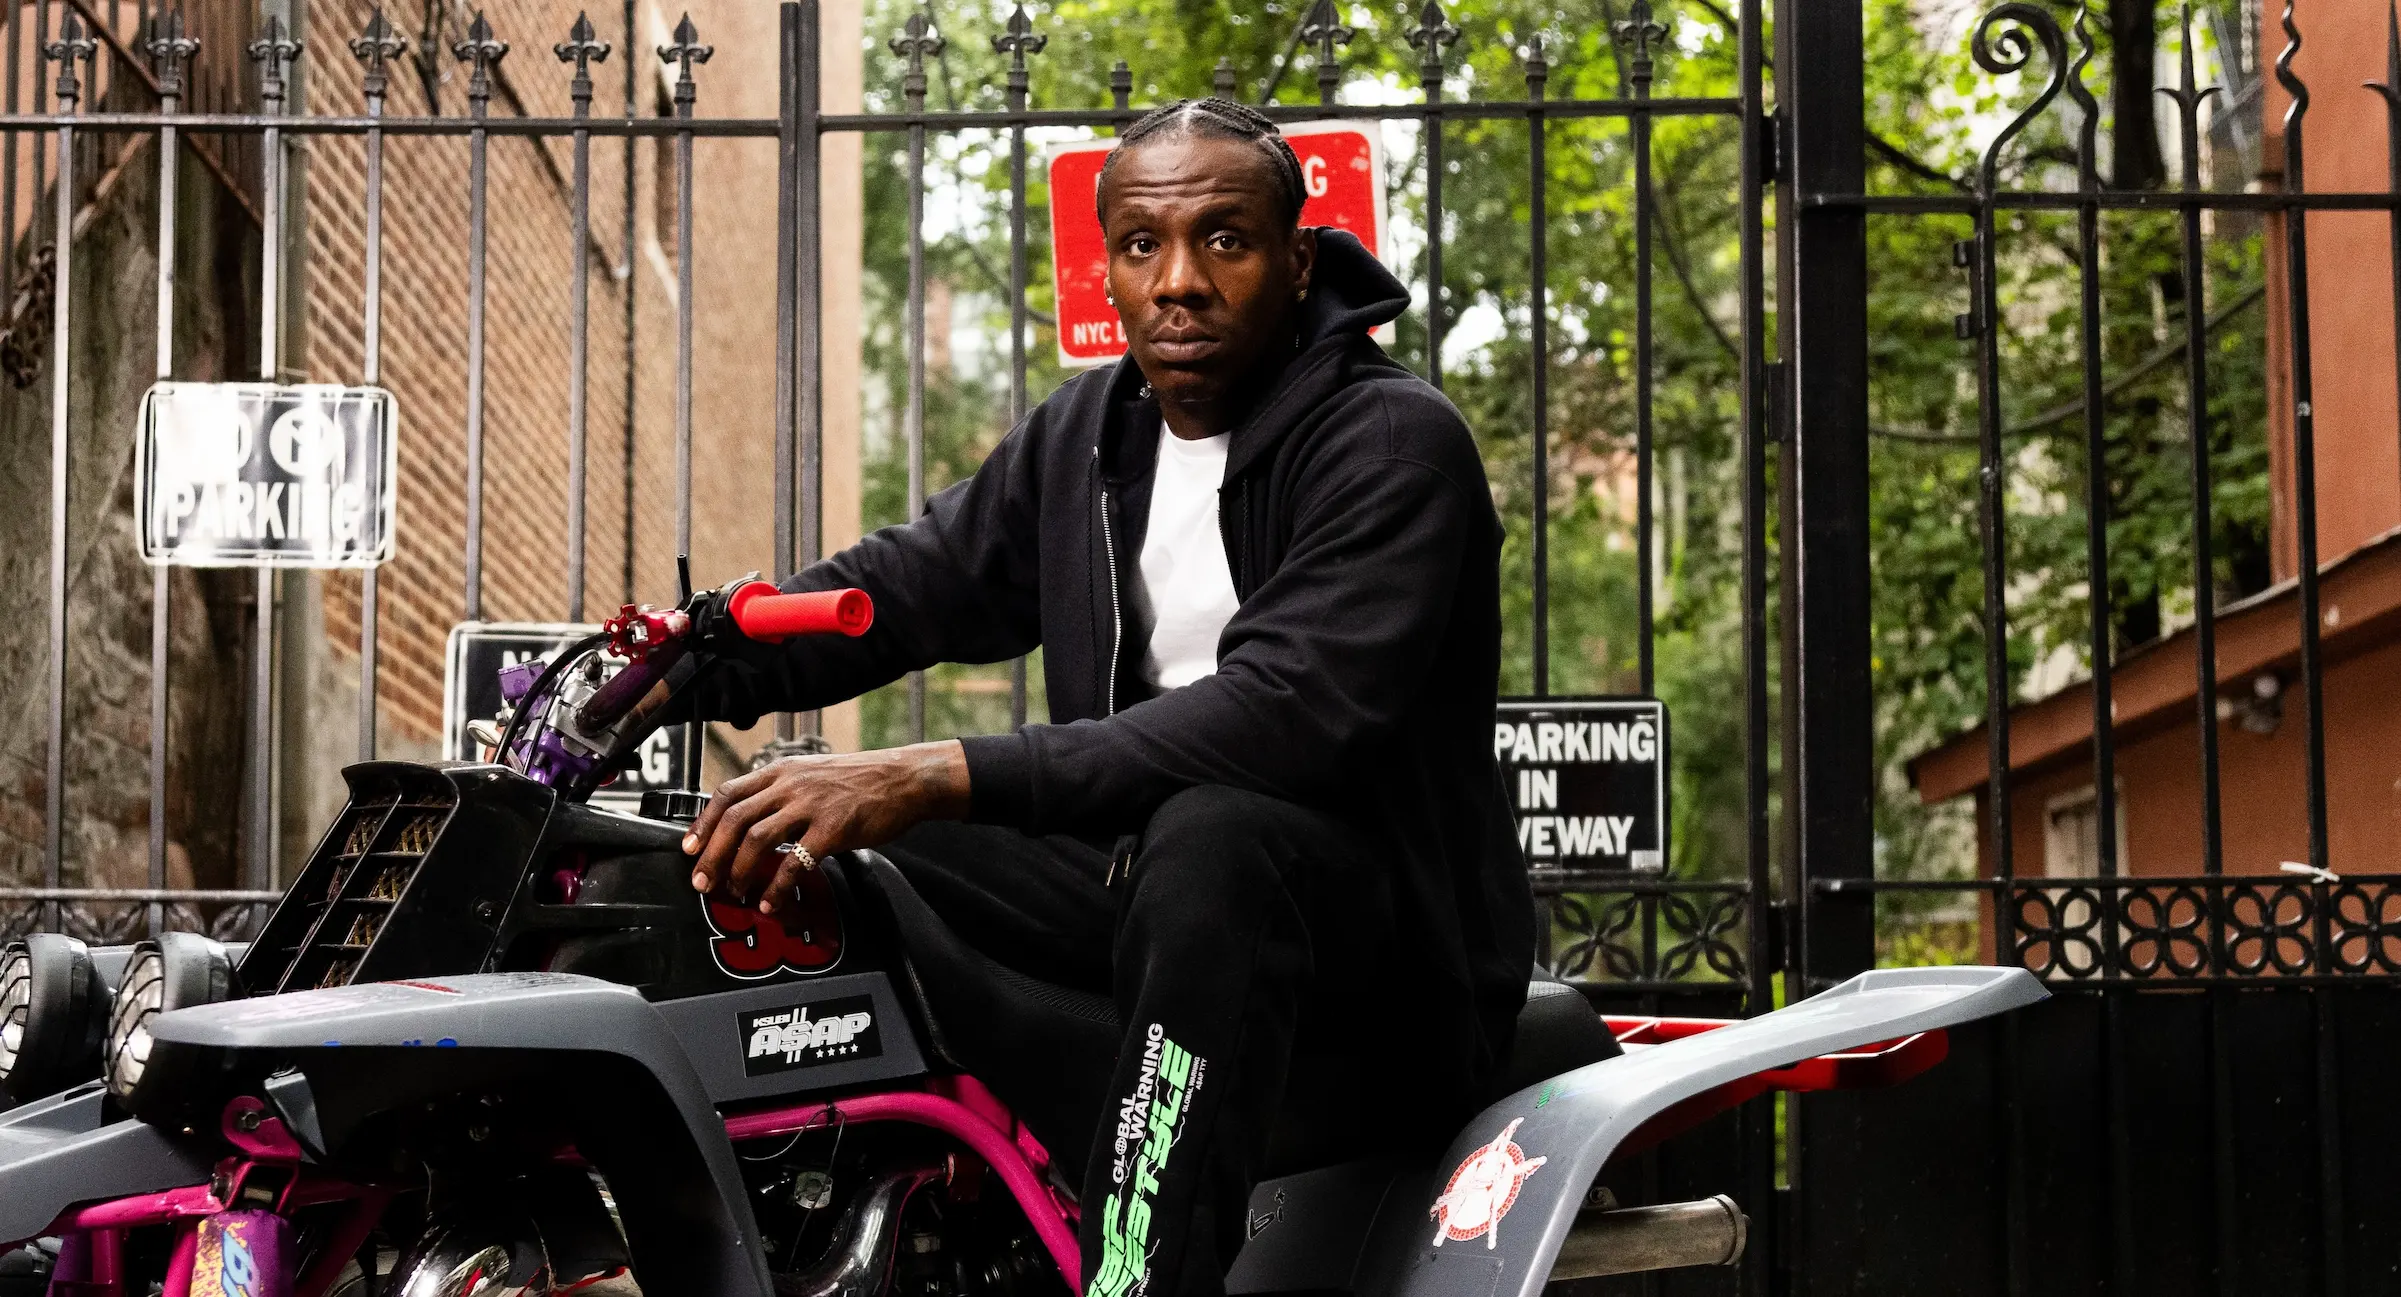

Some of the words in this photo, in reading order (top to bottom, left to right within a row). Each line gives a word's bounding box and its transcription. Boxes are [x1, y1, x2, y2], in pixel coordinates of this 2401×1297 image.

[1073, 323, 1112, 344] NYC
[1495, 722, 1655, 762] PARKING
[1520, 770, 1557, 809] IN
